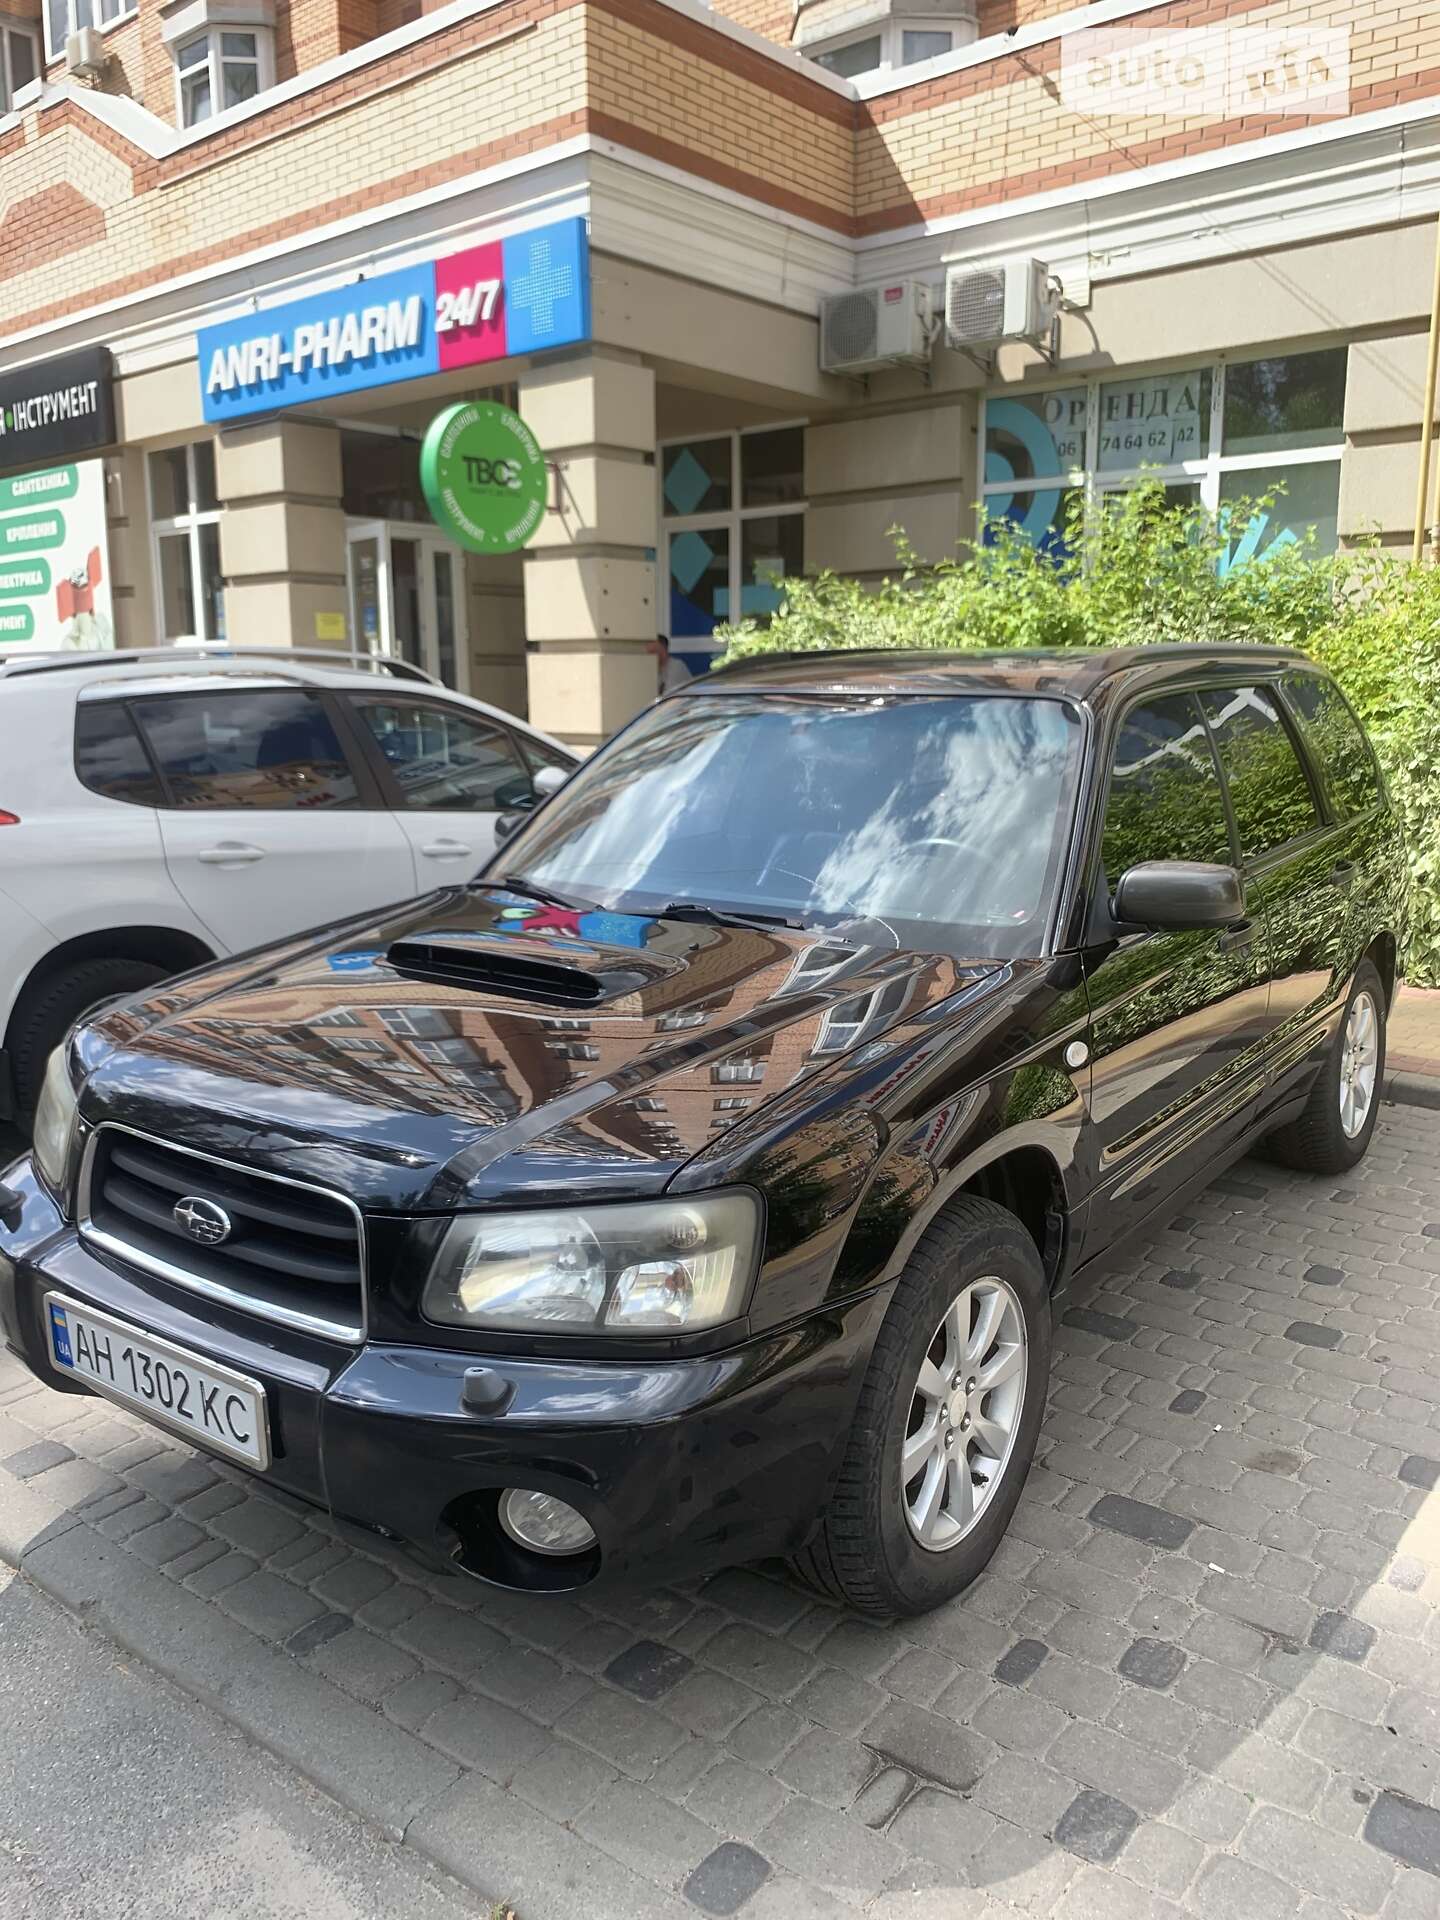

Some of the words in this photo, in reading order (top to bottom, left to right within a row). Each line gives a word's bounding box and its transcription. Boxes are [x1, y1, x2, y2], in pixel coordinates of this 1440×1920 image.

[206, 296, 421, 394] ANRI-PHARM
[435, 280, 500, 332] 24/7
[12, 380, 98, 432] ІНСТРУМЕНТ
[1043, 385, 1197, 426] ОРЕНДА
[12, 471, 71, 497] САНТЕХНІКА
[57, 1341, 71, 1357] UA
[76, 1322, 115, 1382] AH
[122, 1346, 193, 1419] 1302
[199, 1379, 250, 1443] KC
